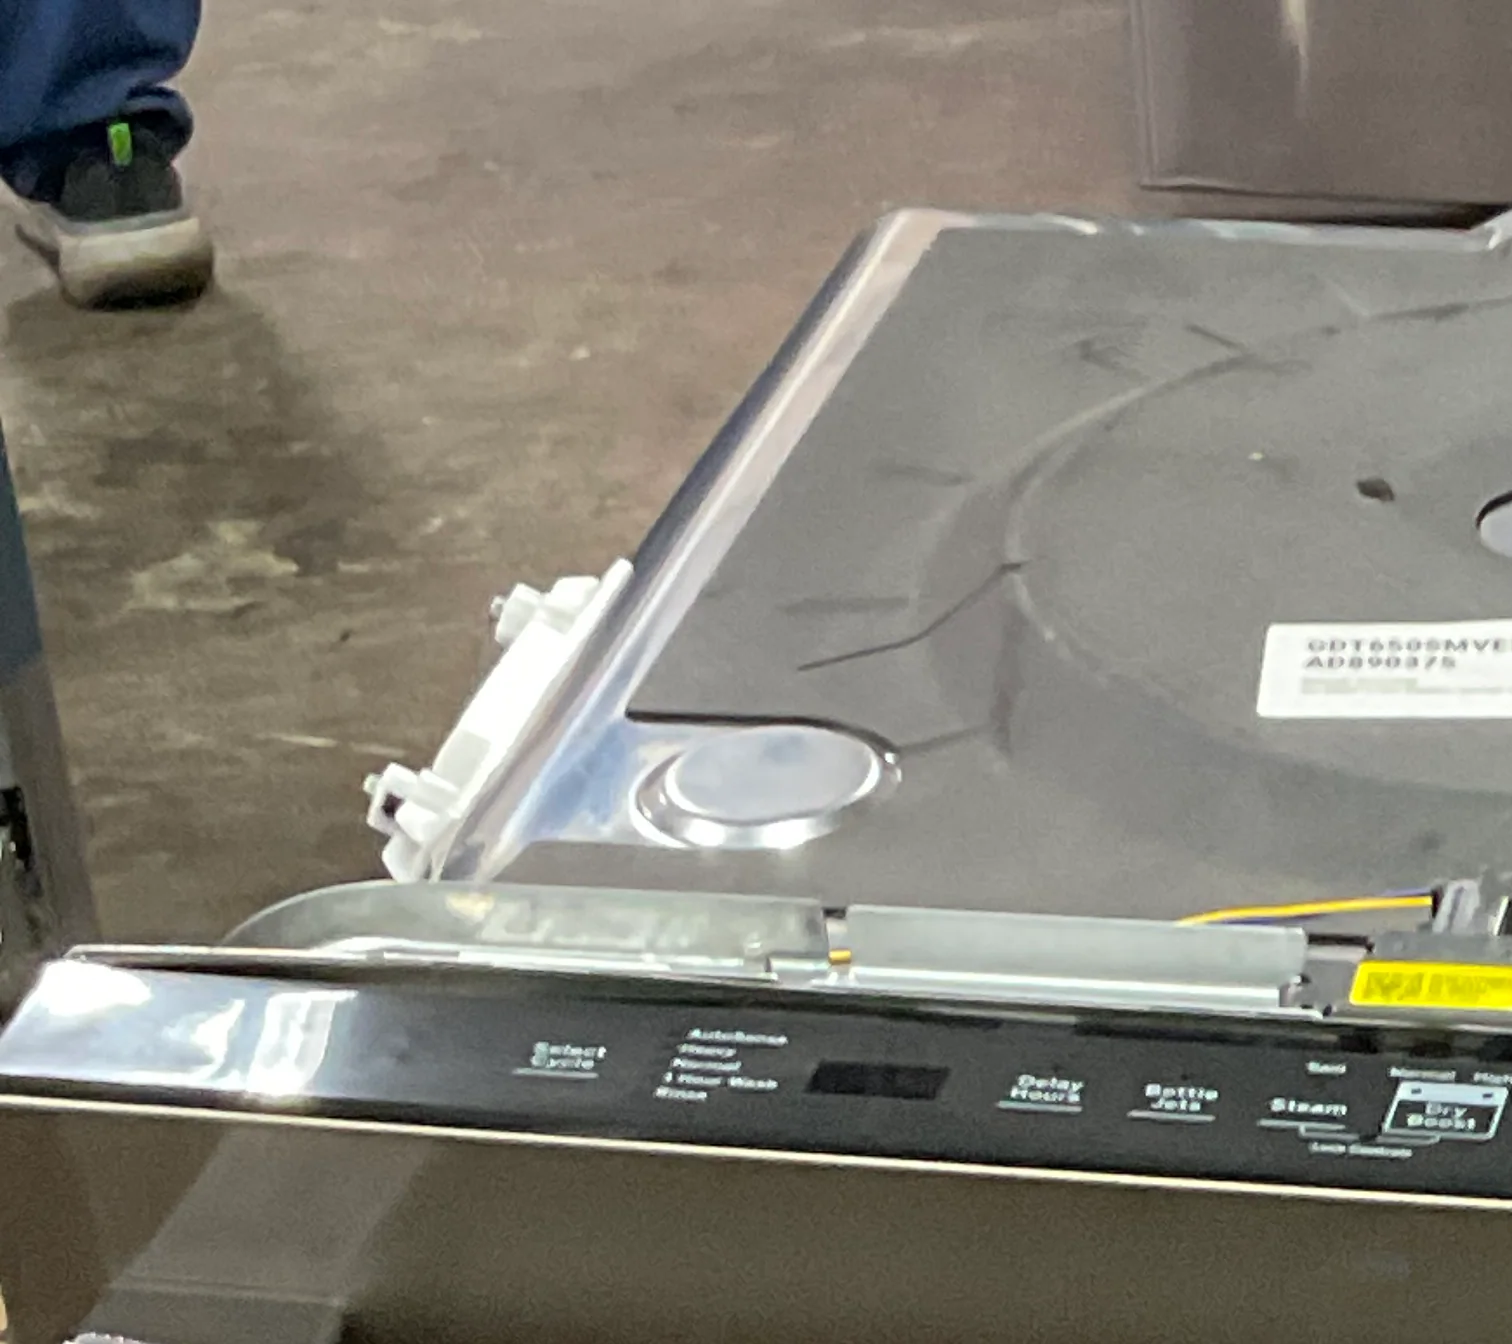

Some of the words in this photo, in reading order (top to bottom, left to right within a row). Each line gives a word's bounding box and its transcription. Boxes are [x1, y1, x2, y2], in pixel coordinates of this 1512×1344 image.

[1017, 1074, 1085, 1092] Delay
[1145, 1083, 1219, 1101] Bottle
[1010, 1086, 1081, 1102] Hours
[1269, 1097, 1348, 1116] Steam
[1407, 1113, 1477, 1131] Boost
